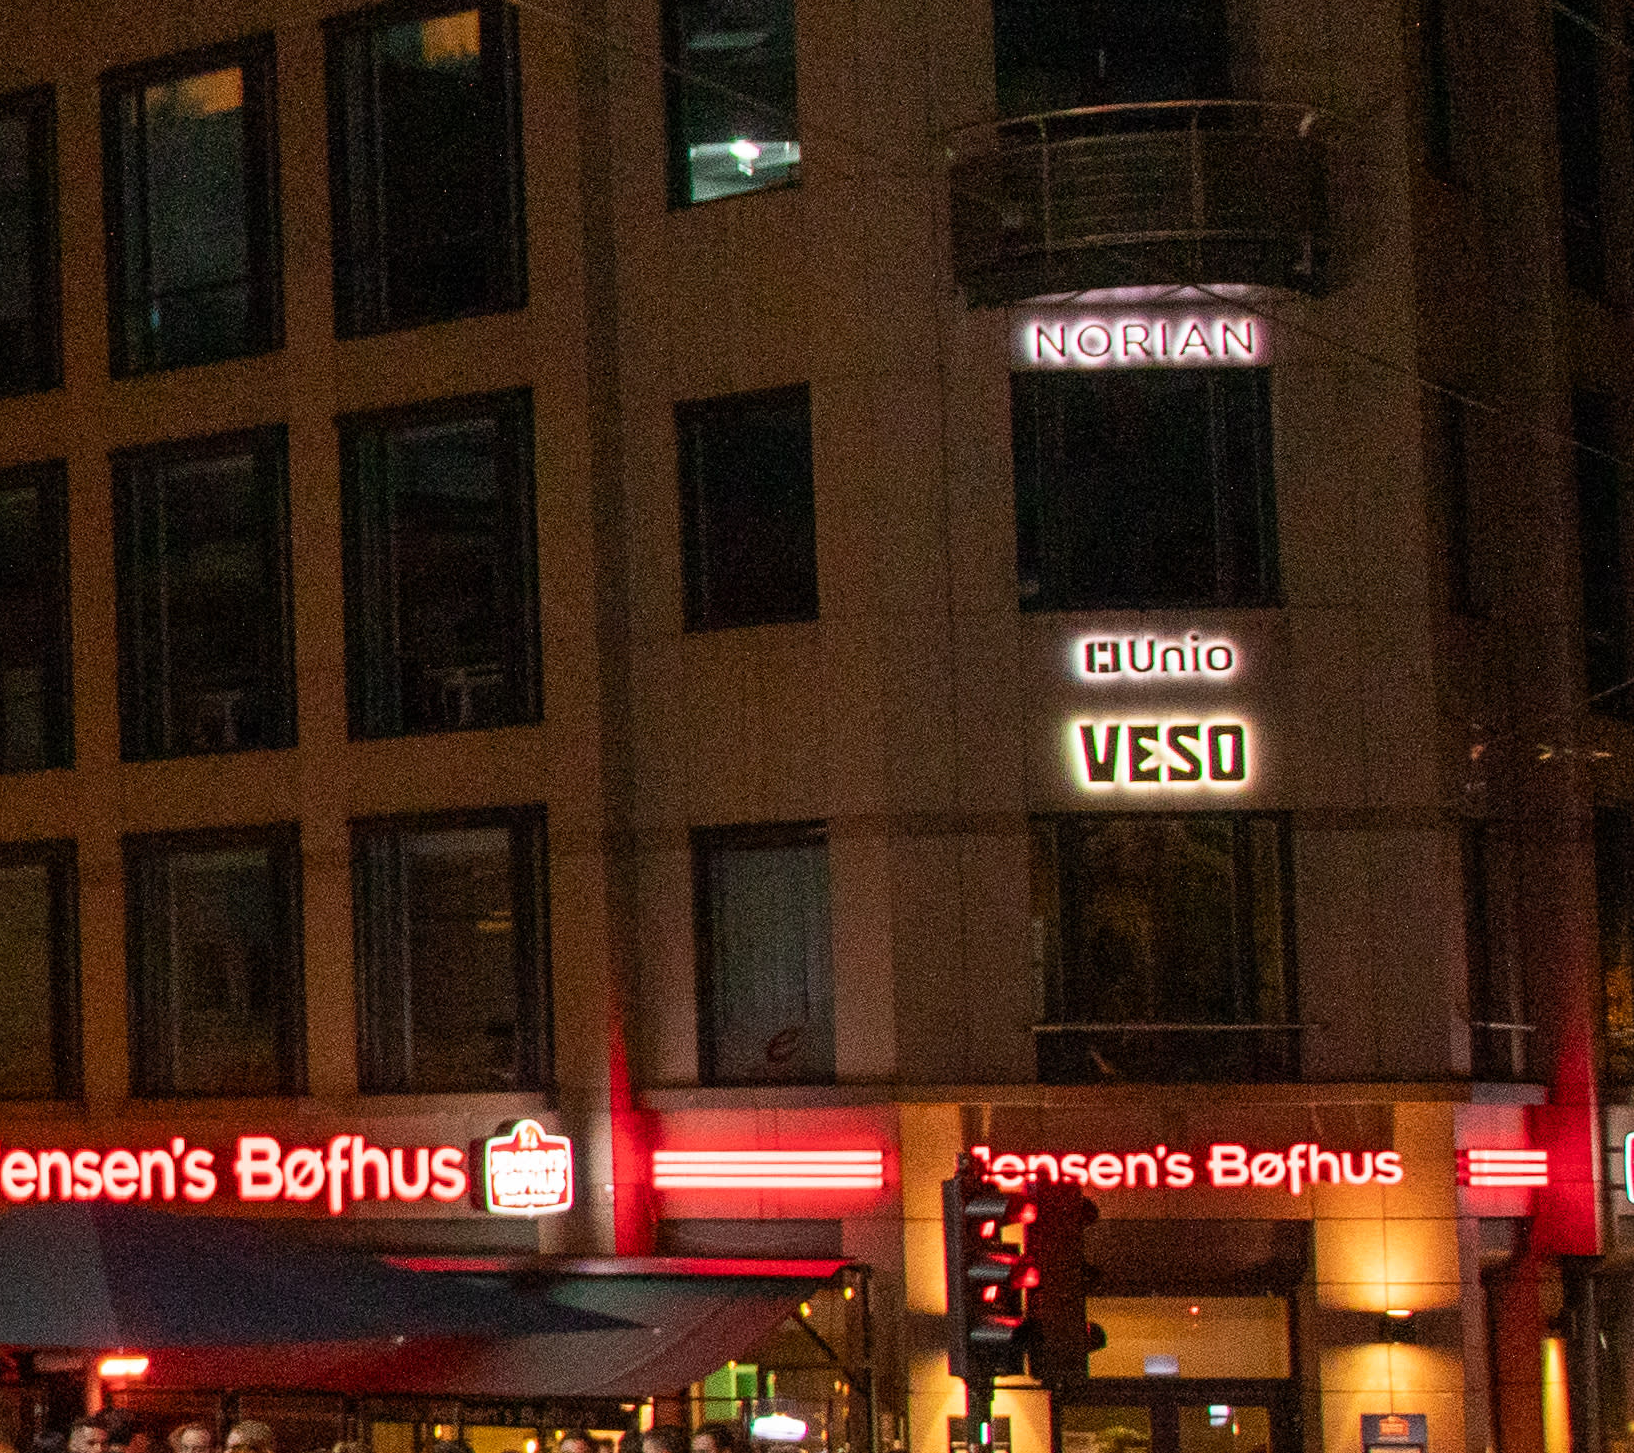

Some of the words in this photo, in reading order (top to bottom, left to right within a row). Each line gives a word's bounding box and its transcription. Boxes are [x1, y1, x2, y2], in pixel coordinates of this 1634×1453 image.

[1035, 323, 1255, 359] NORIAN
[1127, 634, 1235, 674] Unio
[1079, 723, 1247, 782] VESO
[234, 1134, 467, 1216] Bøfhus
[1207, 1144, 1404, 1196] Bøfhus
